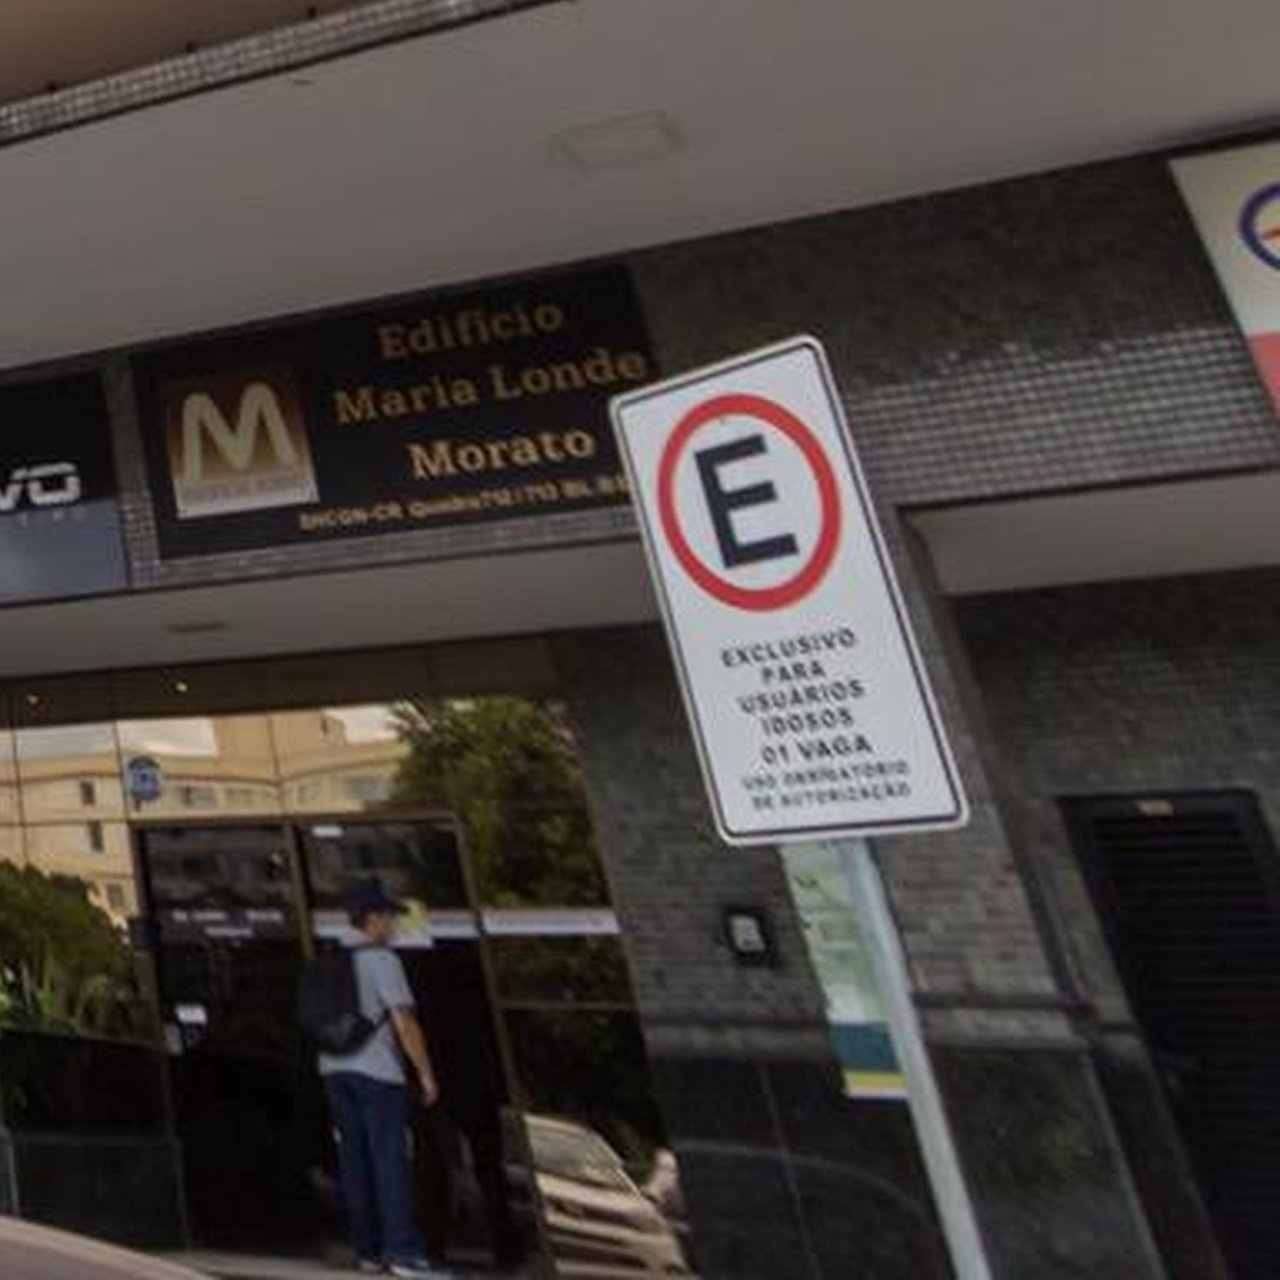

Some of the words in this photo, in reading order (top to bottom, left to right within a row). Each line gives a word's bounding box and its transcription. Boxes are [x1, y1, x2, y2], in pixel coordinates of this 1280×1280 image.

[333, 376, 480, 424] Maria
[407, 425, 596, 480] Morato
[694, 432, 800, 569] E
[720, 627, 856, 668] EXCLUSIVO
[761, 660, 826, 684] PARA
[761, 708, 854, 736] IDOSOS
[761, 744, 789, 764] 01
[796, 734, 873, 760] VAGA
